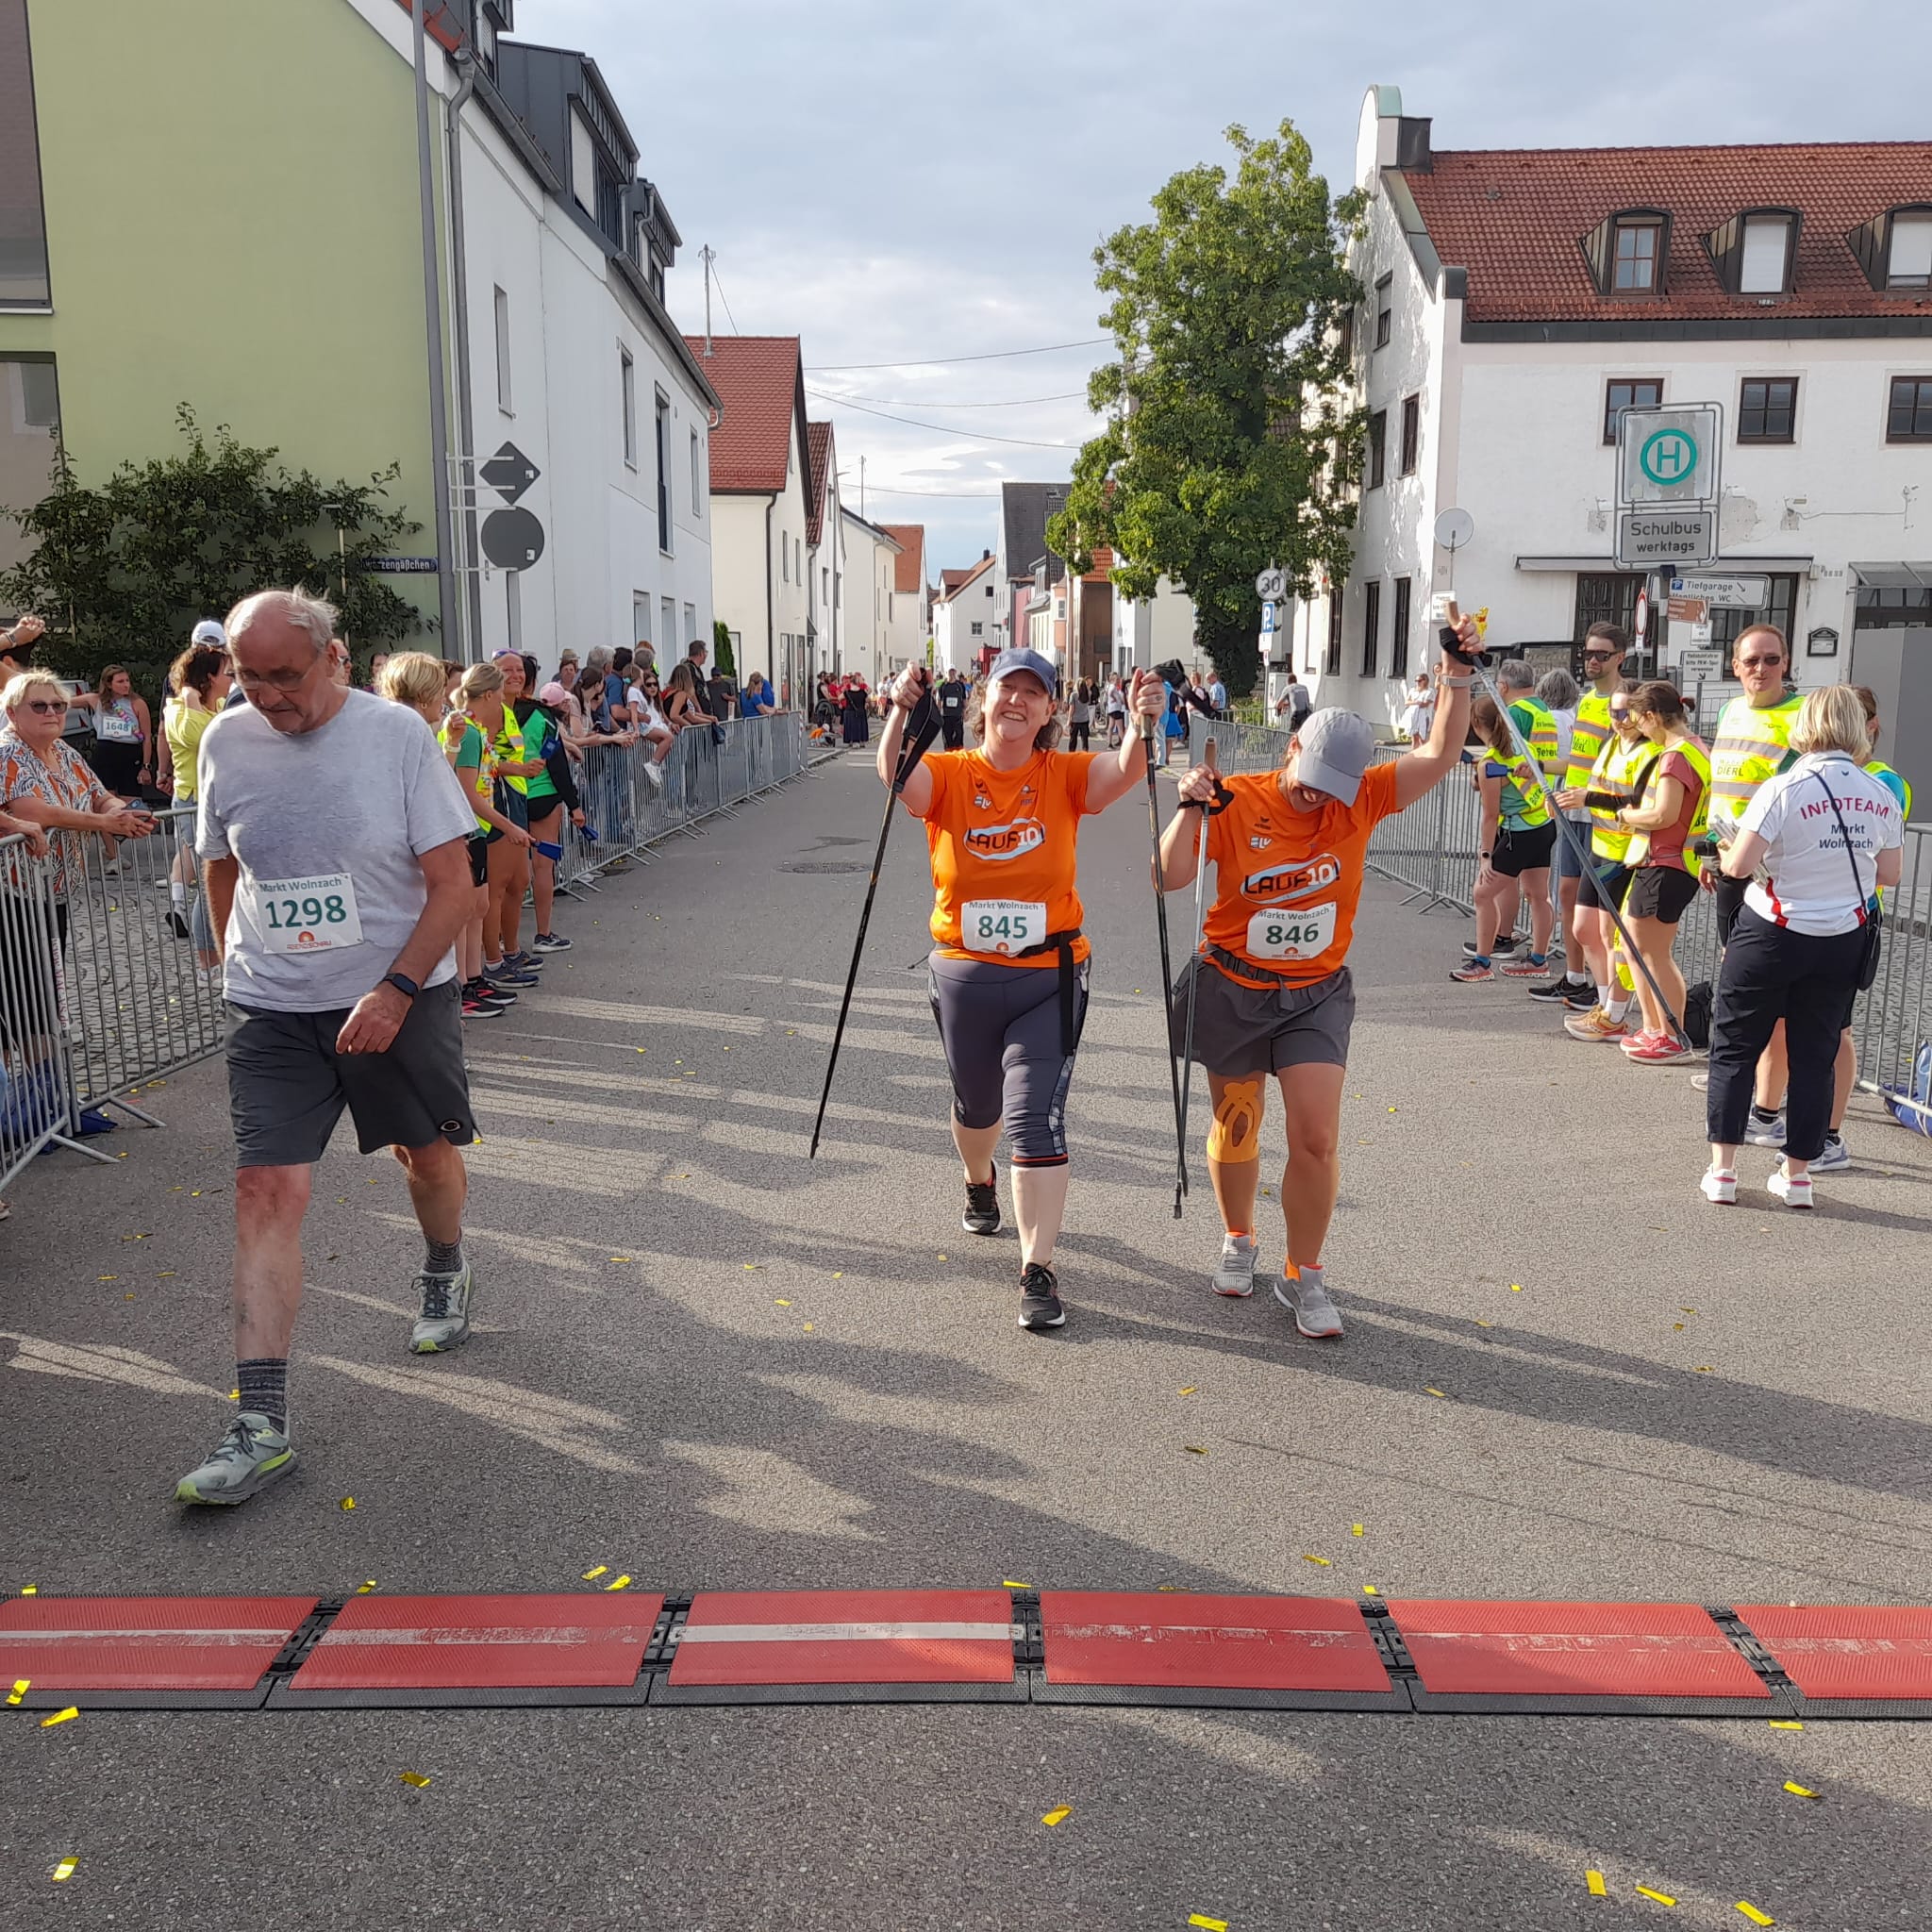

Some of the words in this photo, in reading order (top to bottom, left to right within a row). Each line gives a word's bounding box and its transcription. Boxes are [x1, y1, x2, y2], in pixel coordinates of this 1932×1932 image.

[1657, 441, 1680, 473] H
[1631, 521, 1702, 536] Schulbus
[1637, 541, 1695, 554] werktags
[1261, 576, 1280, 592] 30
[1687, 581, 1733, 591] Tiefgarage
[106, 722, 129, 732] 1648
[1717, 766, 1744, 776] DIERL
[1800, 797, 1890, 820] INFOTEAM
[259, 883, 287, 892] Markt
[288, 876, 341, 891] Wolnzach
[265, 895, 346, 928] 1298
[997, 902, 1039, 910] Wolnzach
[1257, 910, 1285, 920] Markt
[1288, 907, 1329, 921] Wolnzach
[978, 915, 1028, 939] 845
[1265, 923, 1319, 944] 846
